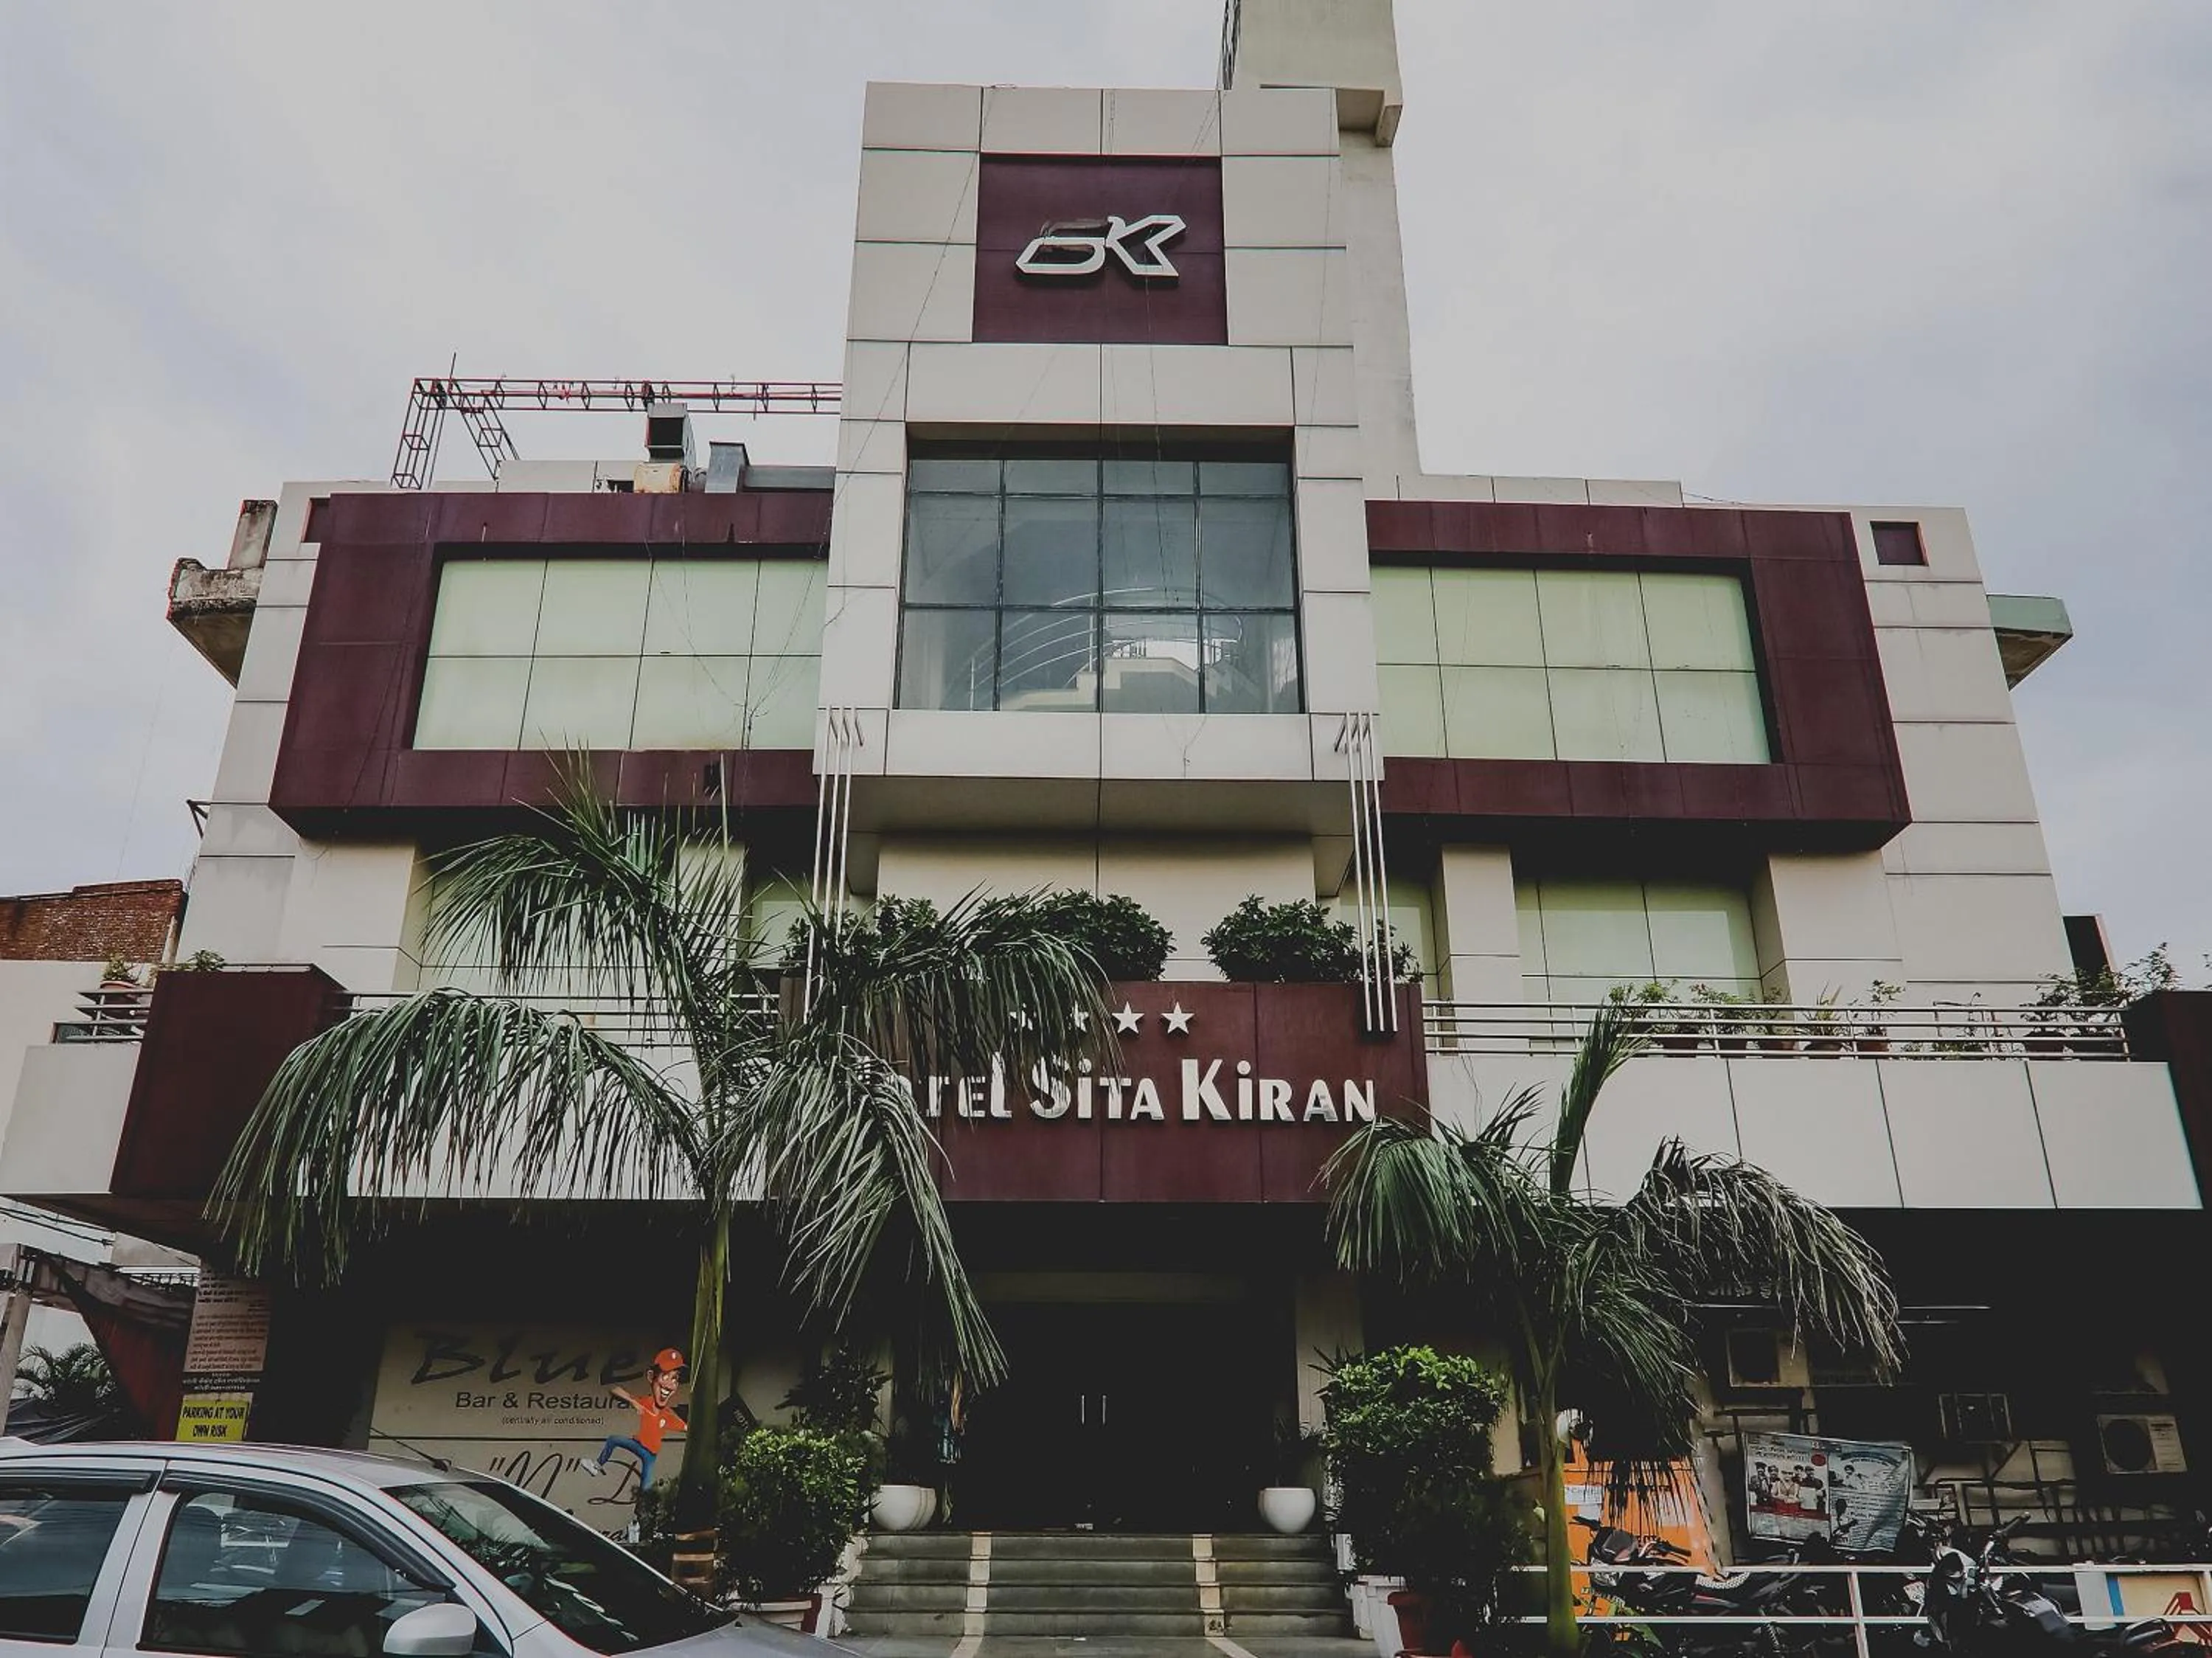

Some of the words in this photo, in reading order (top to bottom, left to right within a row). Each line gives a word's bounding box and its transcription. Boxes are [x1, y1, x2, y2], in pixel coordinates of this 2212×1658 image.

[411, 1330, 645, 1385] Blue
[456, 1392, 495, 1409] Bar
[502, 1392, 518, 1409] &
[527, 1392, 638, 1409] Restaura
[183, 1406, 213, 1418] PARKING
[214, 1406, 224, 1419] AT
[225, 1406, 246, 1420] YOUR
[192, 1424, 209, 1437] OWN
[209, 1424, 228, 1437] RISK
